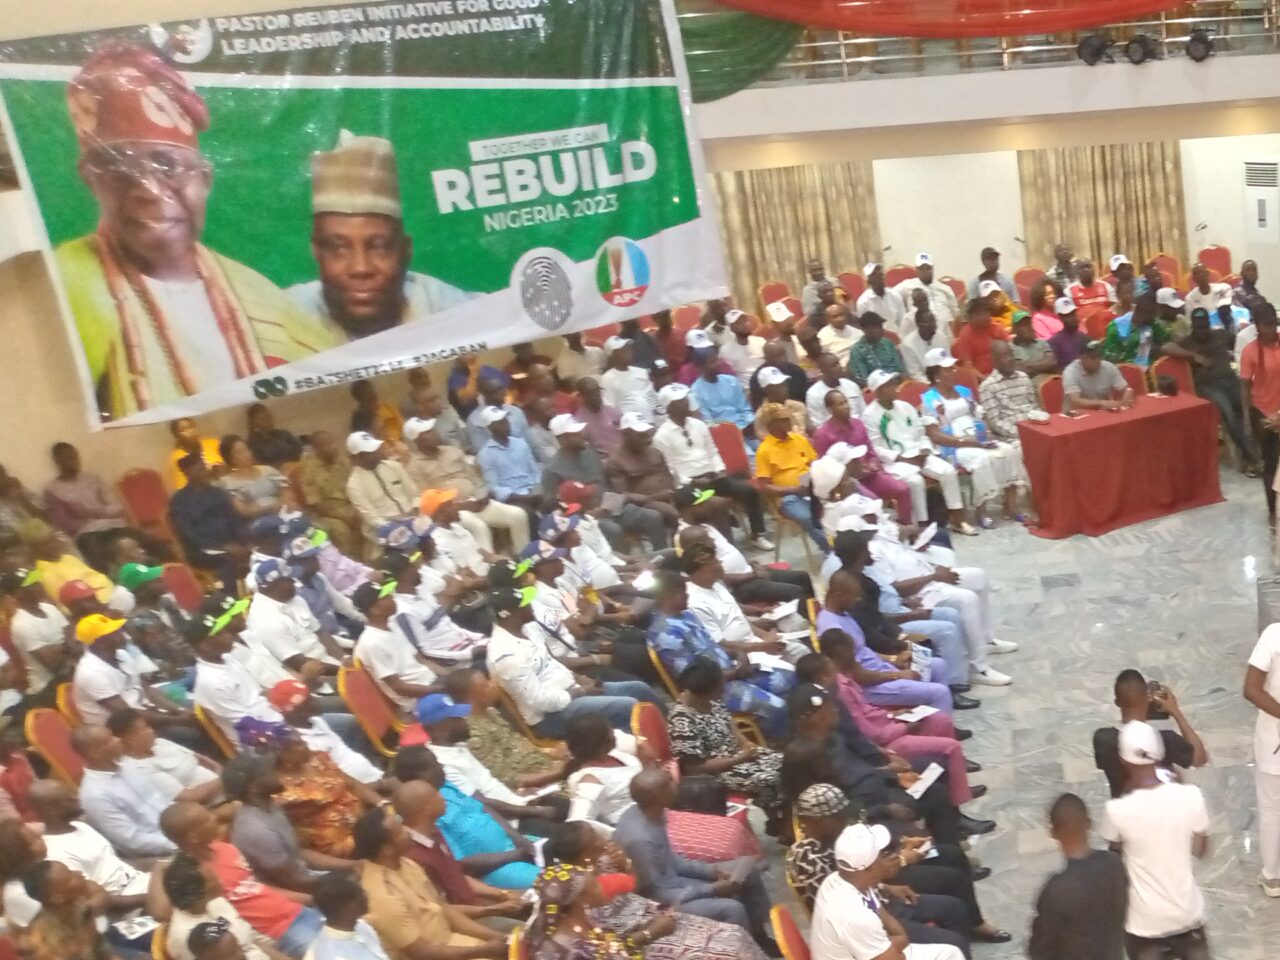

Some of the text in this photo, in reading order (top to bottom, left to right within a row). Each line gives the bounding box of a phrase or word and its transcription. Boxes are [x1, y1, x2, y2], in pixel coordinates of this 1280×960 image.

[214, 14, 291, 33] PASTOR
[292, 7, 365, 28] REUBEN
[367, 1, 455, 20] INITIATIVE
[456, 0, 490, 14] FOR
[220, 13, 546, 56] LEADERSHIP AND ACCOUNTABILITY
[481, 137, 547, 155] TOGETHER
[552, 134, 569, 148] WE
[430, 140, 658, 215] REBUILD
[483, 193, 620, 233] NIGERIA 2023
